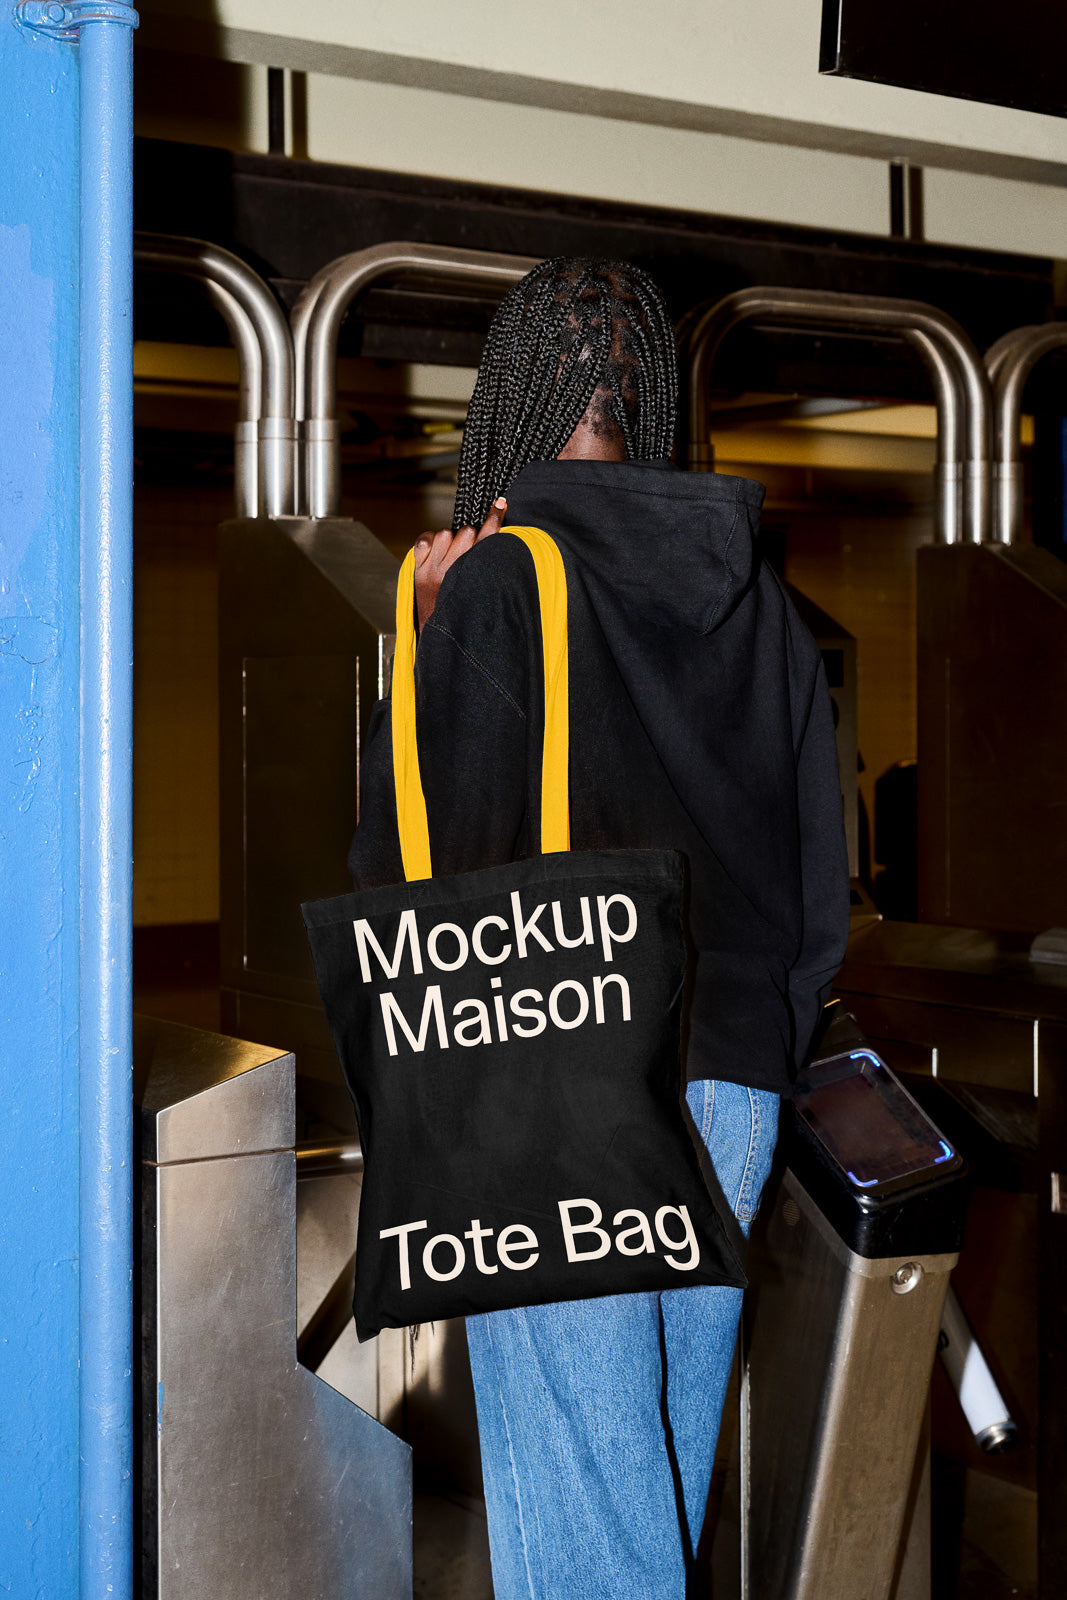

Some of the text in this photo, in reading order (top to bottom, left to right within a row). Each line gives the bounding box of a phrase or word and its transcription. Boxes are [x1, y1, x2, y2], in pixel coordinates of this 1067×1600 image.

[353, 891, 638, 984] Mockup
[379, 973, 632, 1057] Maison
[378, 1198, 701, 1291] Tote Bag
